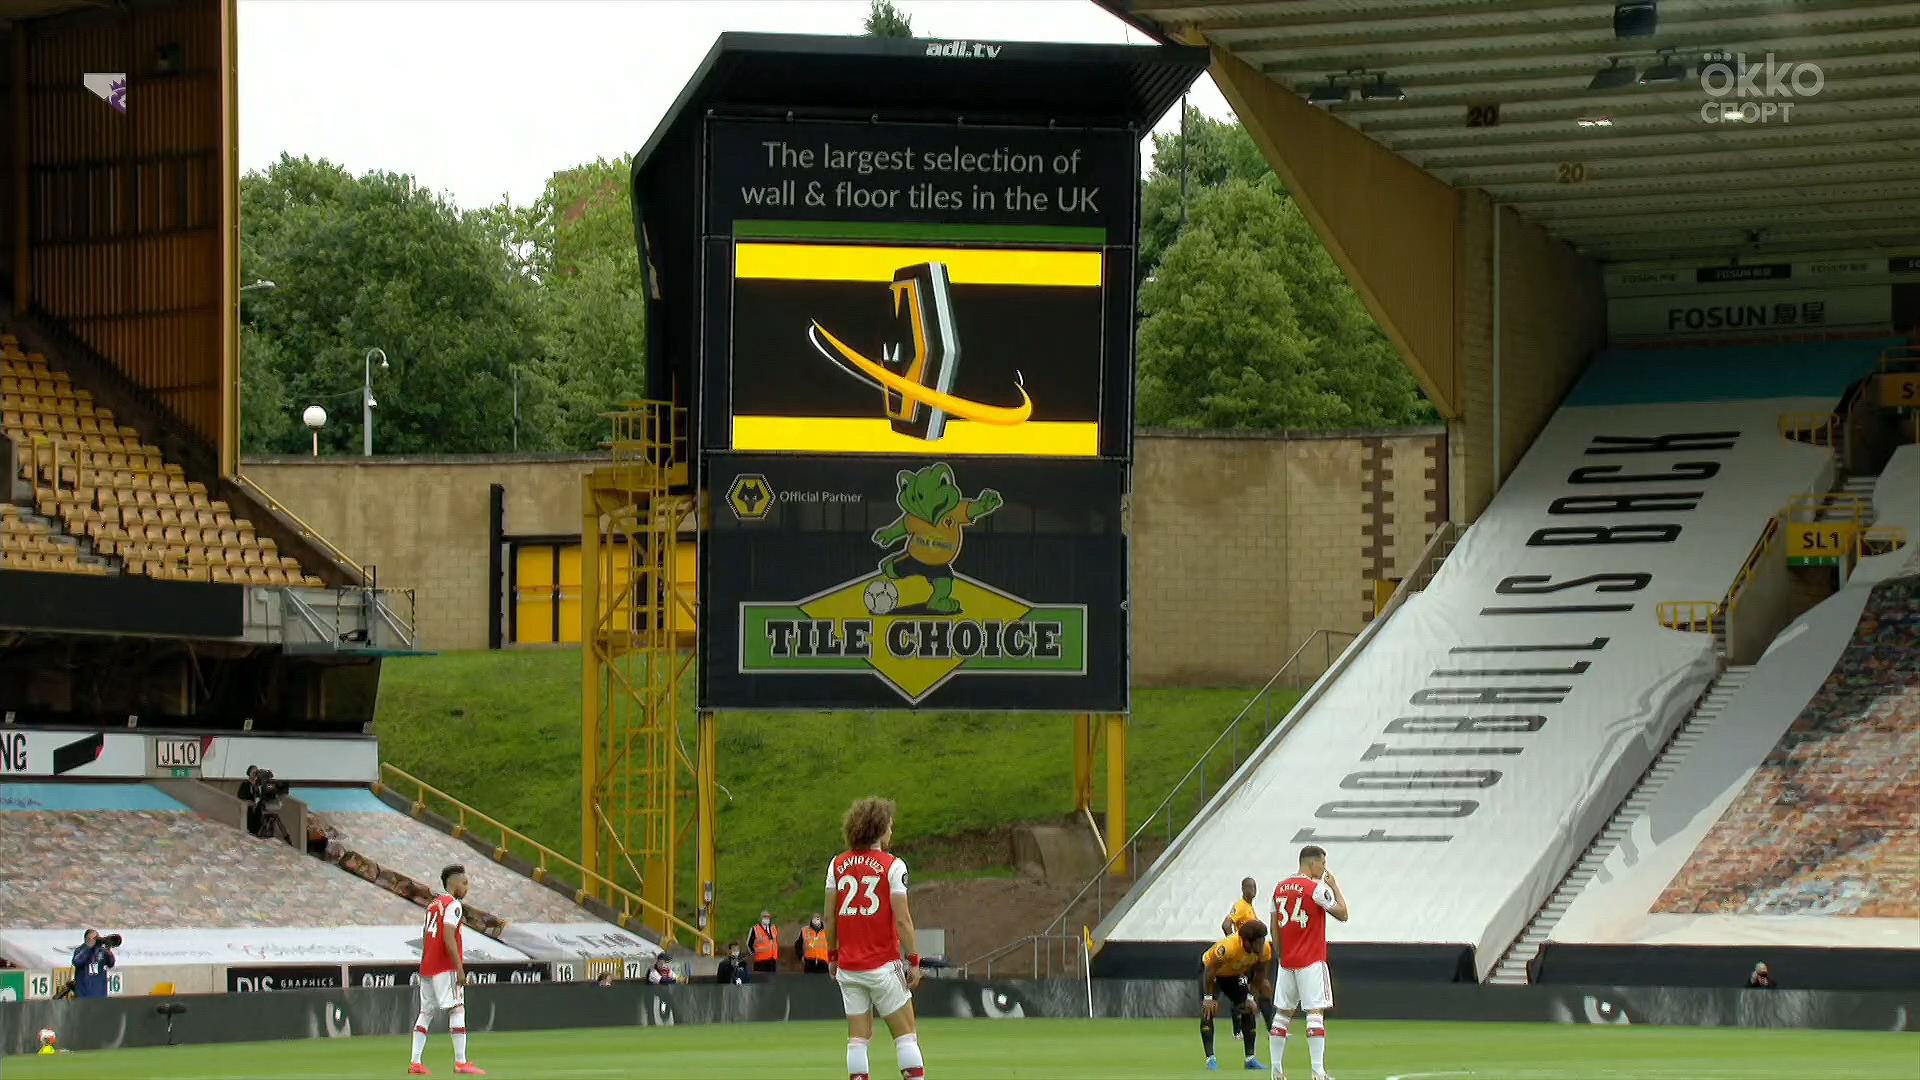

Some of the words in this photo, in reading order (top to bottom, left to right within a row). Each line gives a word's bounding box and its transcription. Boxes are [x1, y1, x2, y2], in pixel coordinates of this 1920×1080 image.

[926, 40, 1002, 59] adi.tv
[1468, 105, 1498, 127] 20
[762, 141, 815, 169] The
[823, 143, 916, 174] largest
[923, 146, 1044, 173] selection
[1052, 149, 1082, 174] of
[1558, 162, 1585, 184] 20
[741, 179, 796, 207] wall
[804, 180, 826, 207] &
[836, 181, 901, 208] floor
[907, 183, 963, 210] tiles
[971, 184, 996, 210] in
[1004, 186, 1049, 211] the
[1057, 187, 1101, 213] UK
[1668, 303, 1767, 330] FOSUN
[780, 490, 819, 504] Official
[822, 490, 863, 504] Partner
[1525, 430, 1742, 546] BACK
[1802, 531, 1840, 549] SL1
[1480, 572, 1654, 616] IS
[766, 618, 874, 658] TILE
[885, 618, 1063, 659] CHOICE
[1290, 636, 1611, 843] FOOTBALL
[161, 742, 197, 765] JL10
[837, 855, 865, 874] DAVID
[838, 875, 881, 916] 23
[1275, 896, 1309, 929] 34
[626, 962, 638, 979] 17
[31, 976, 49, 995] 15
[280, 976, 335, 989] GRAPHICS
